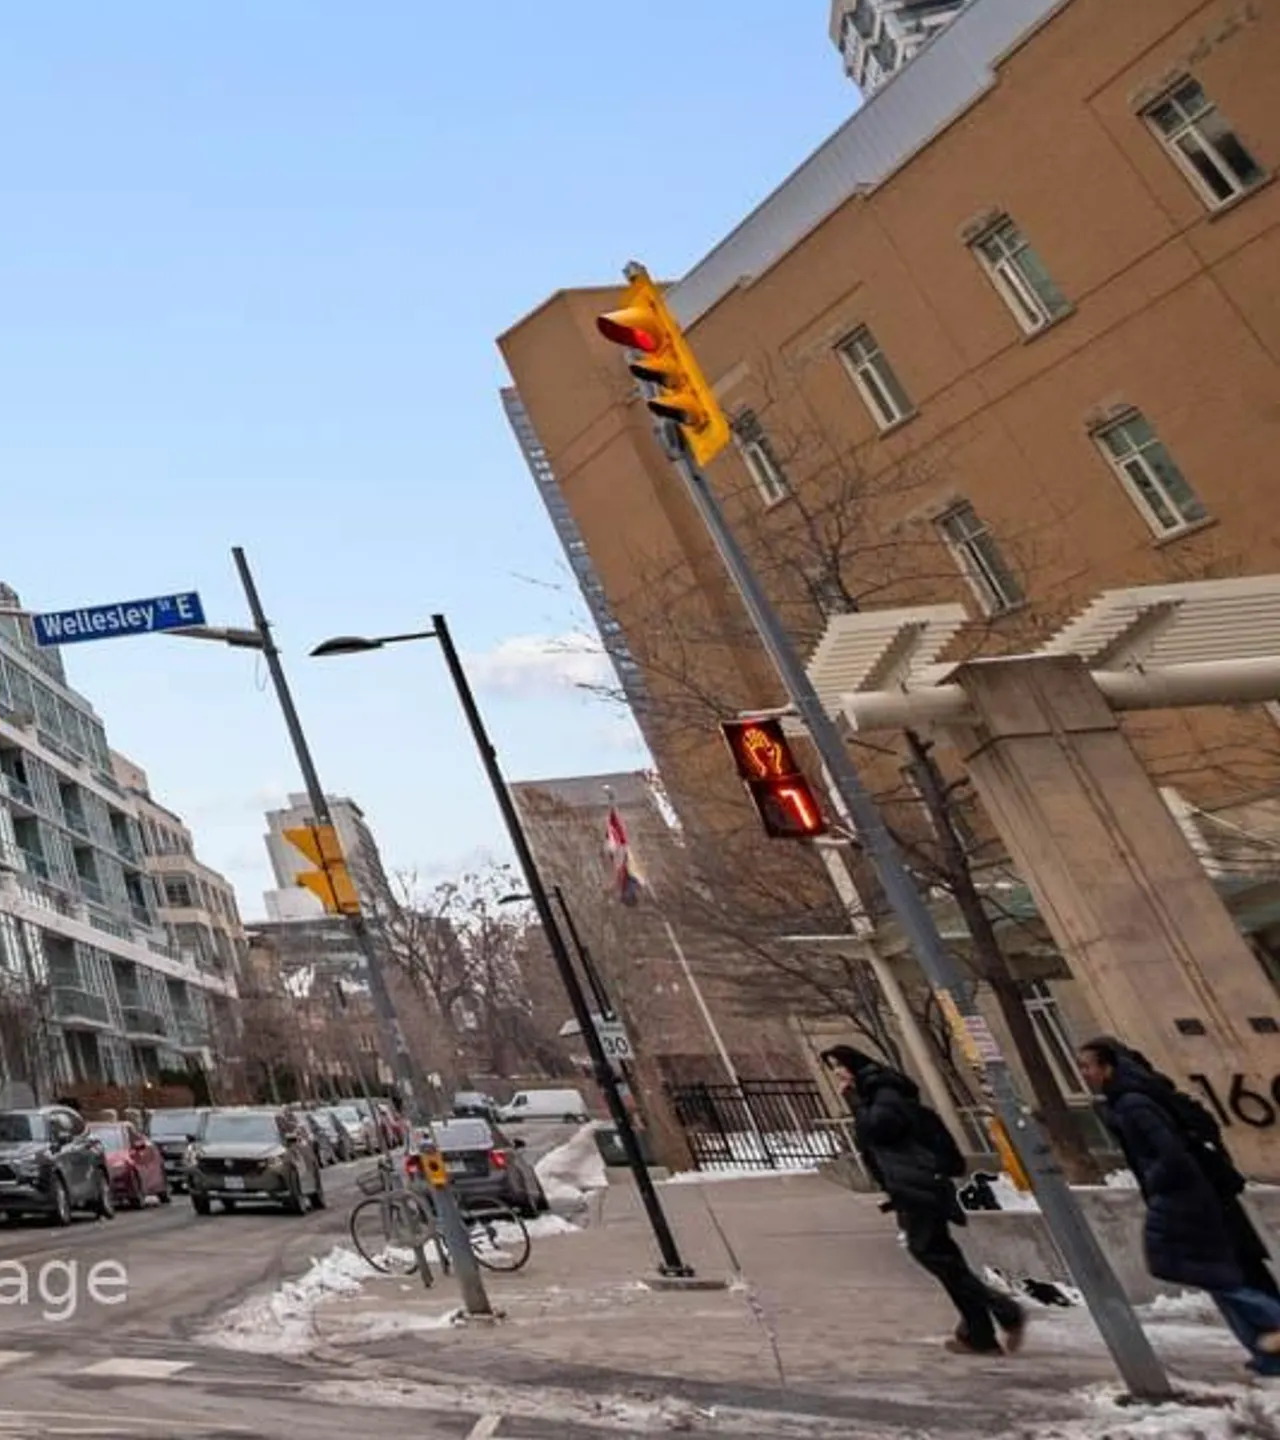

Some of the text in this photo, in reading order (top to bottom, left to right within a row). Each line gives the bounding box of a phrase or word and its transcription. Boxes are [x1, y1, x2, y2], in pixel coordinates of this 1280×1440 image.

[41, 602, 154, 638] Wellesley
[176, 594, 194, 619] E
[1188, 1072, 1280, 1129] 16
